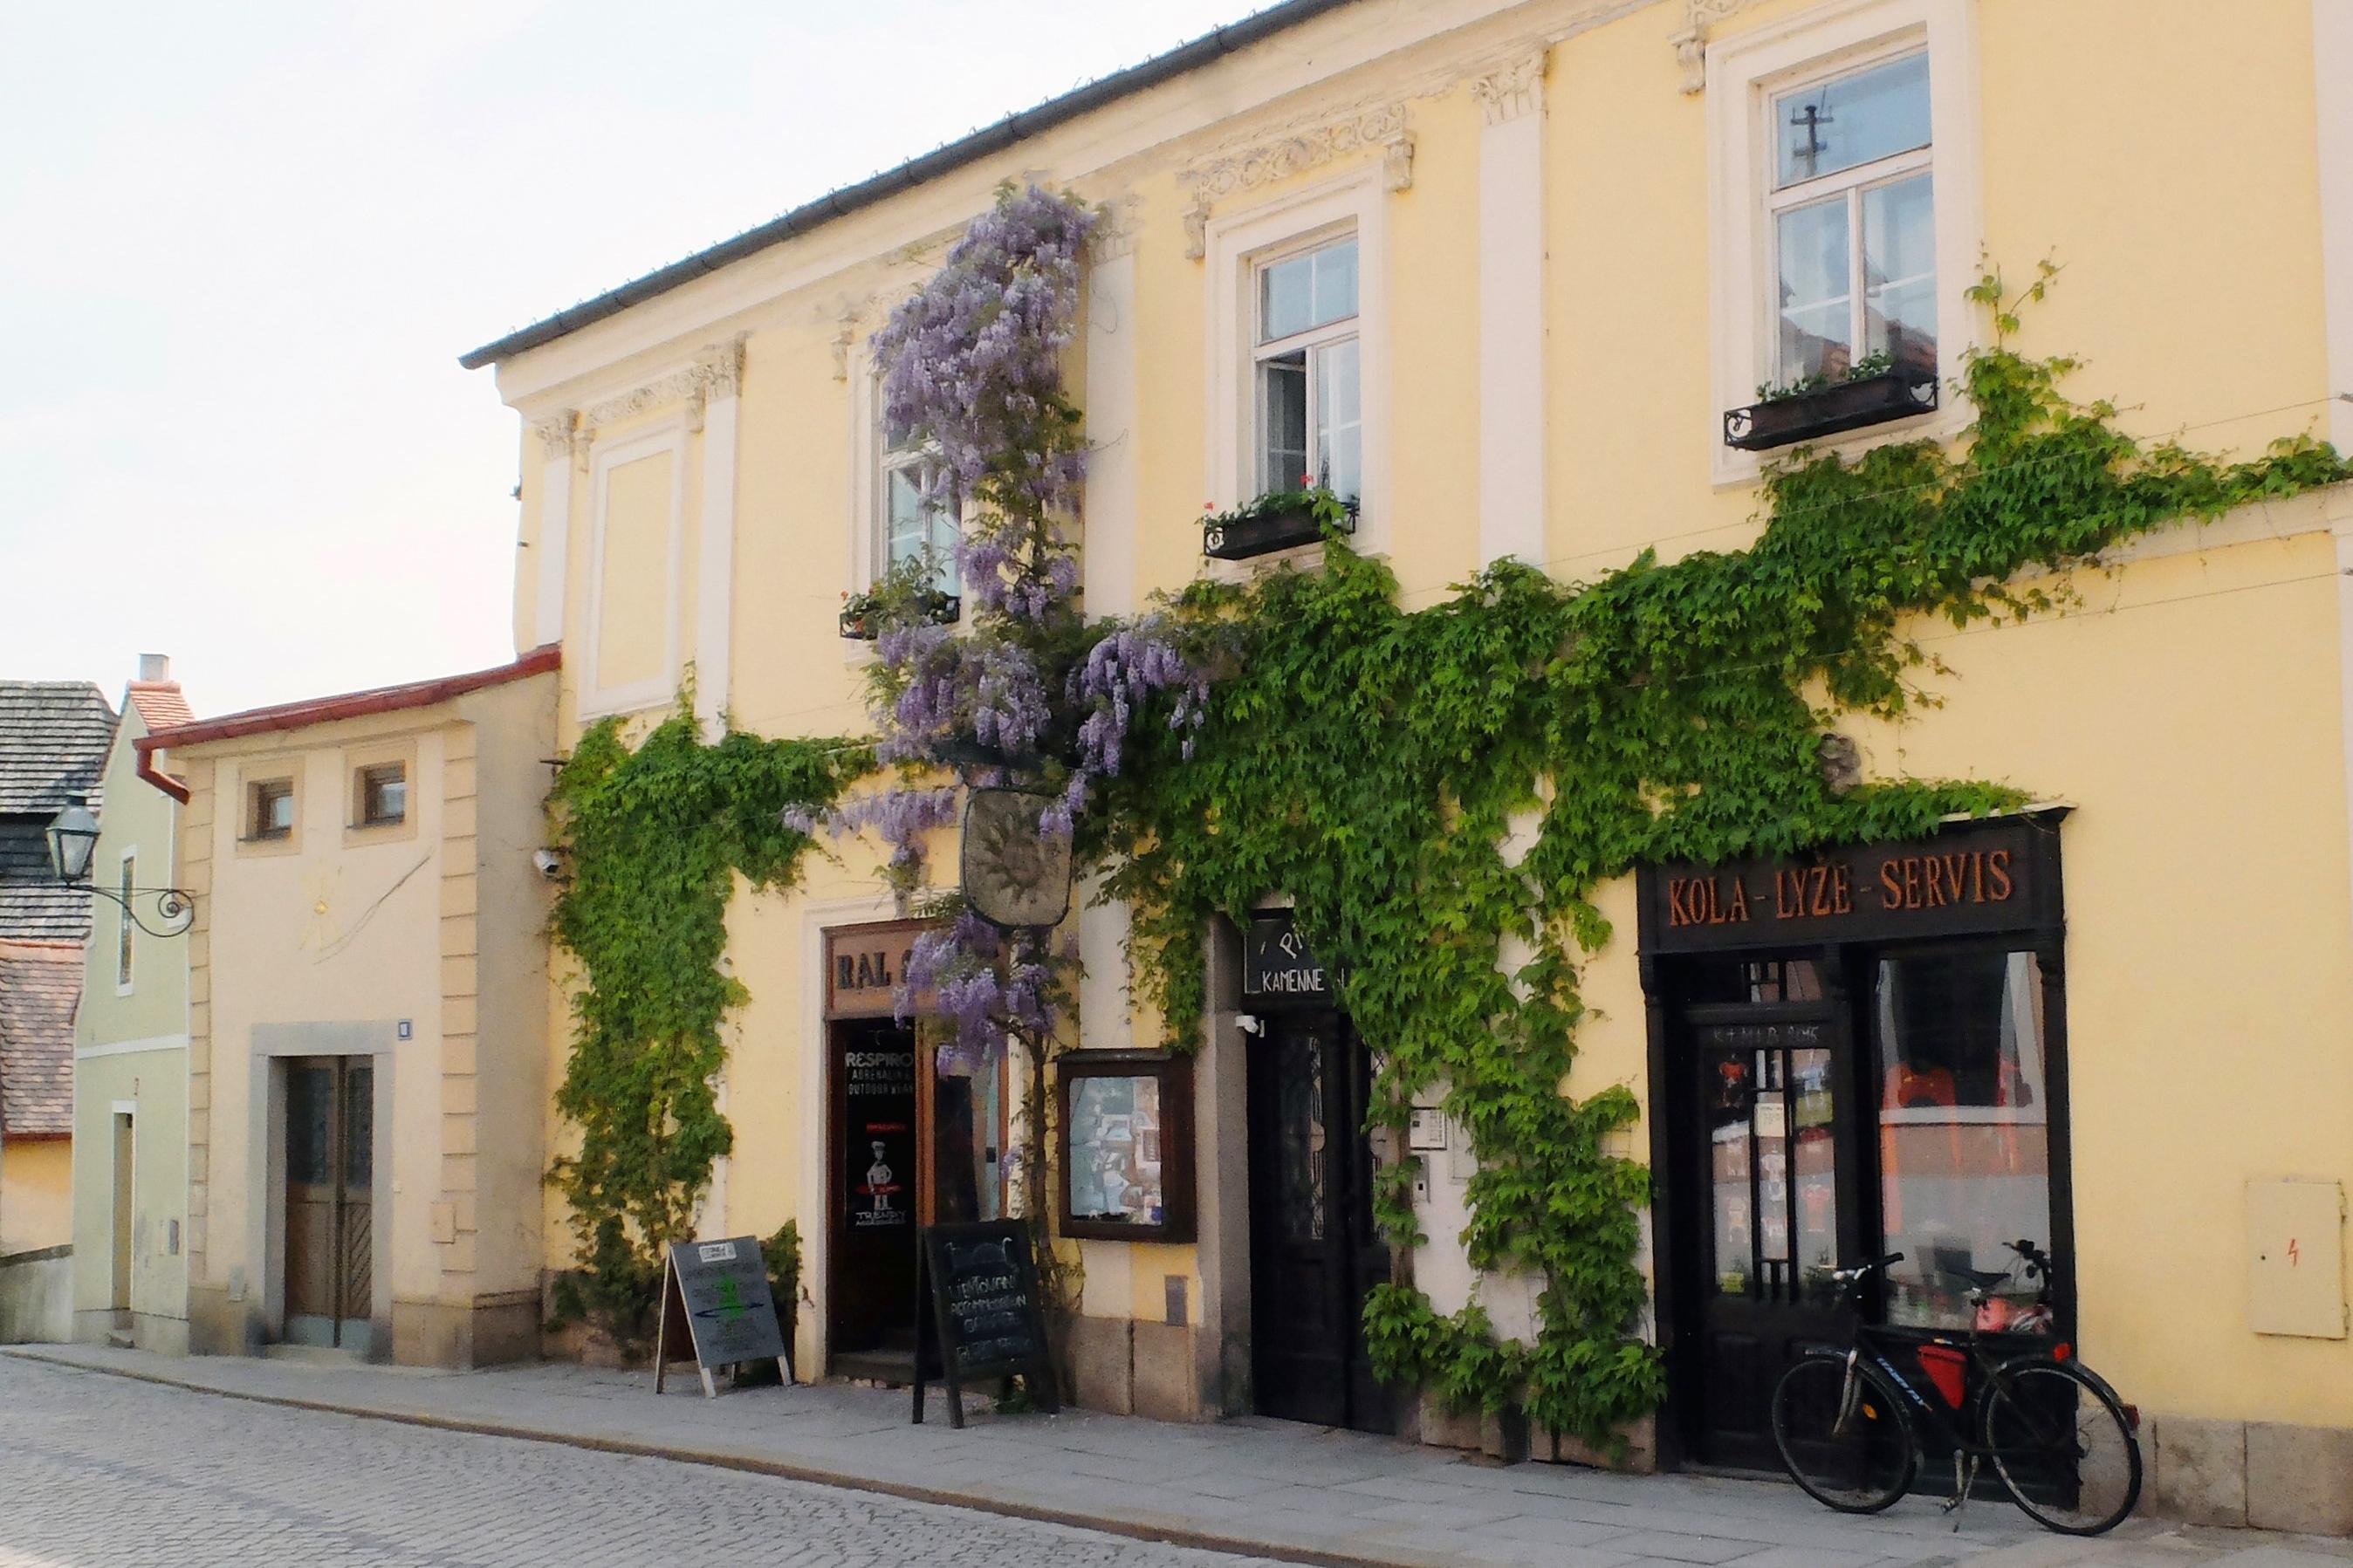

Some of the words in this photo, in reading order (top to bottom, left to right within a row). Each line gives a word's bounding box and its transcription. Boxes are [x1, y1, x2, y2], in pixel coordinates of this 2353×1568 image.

[1668, 877, 1748, 926] KOLA
[1880, 850, 2013, 909] SERVIS
[845, 1052, 914, 1067] RESPIRO
